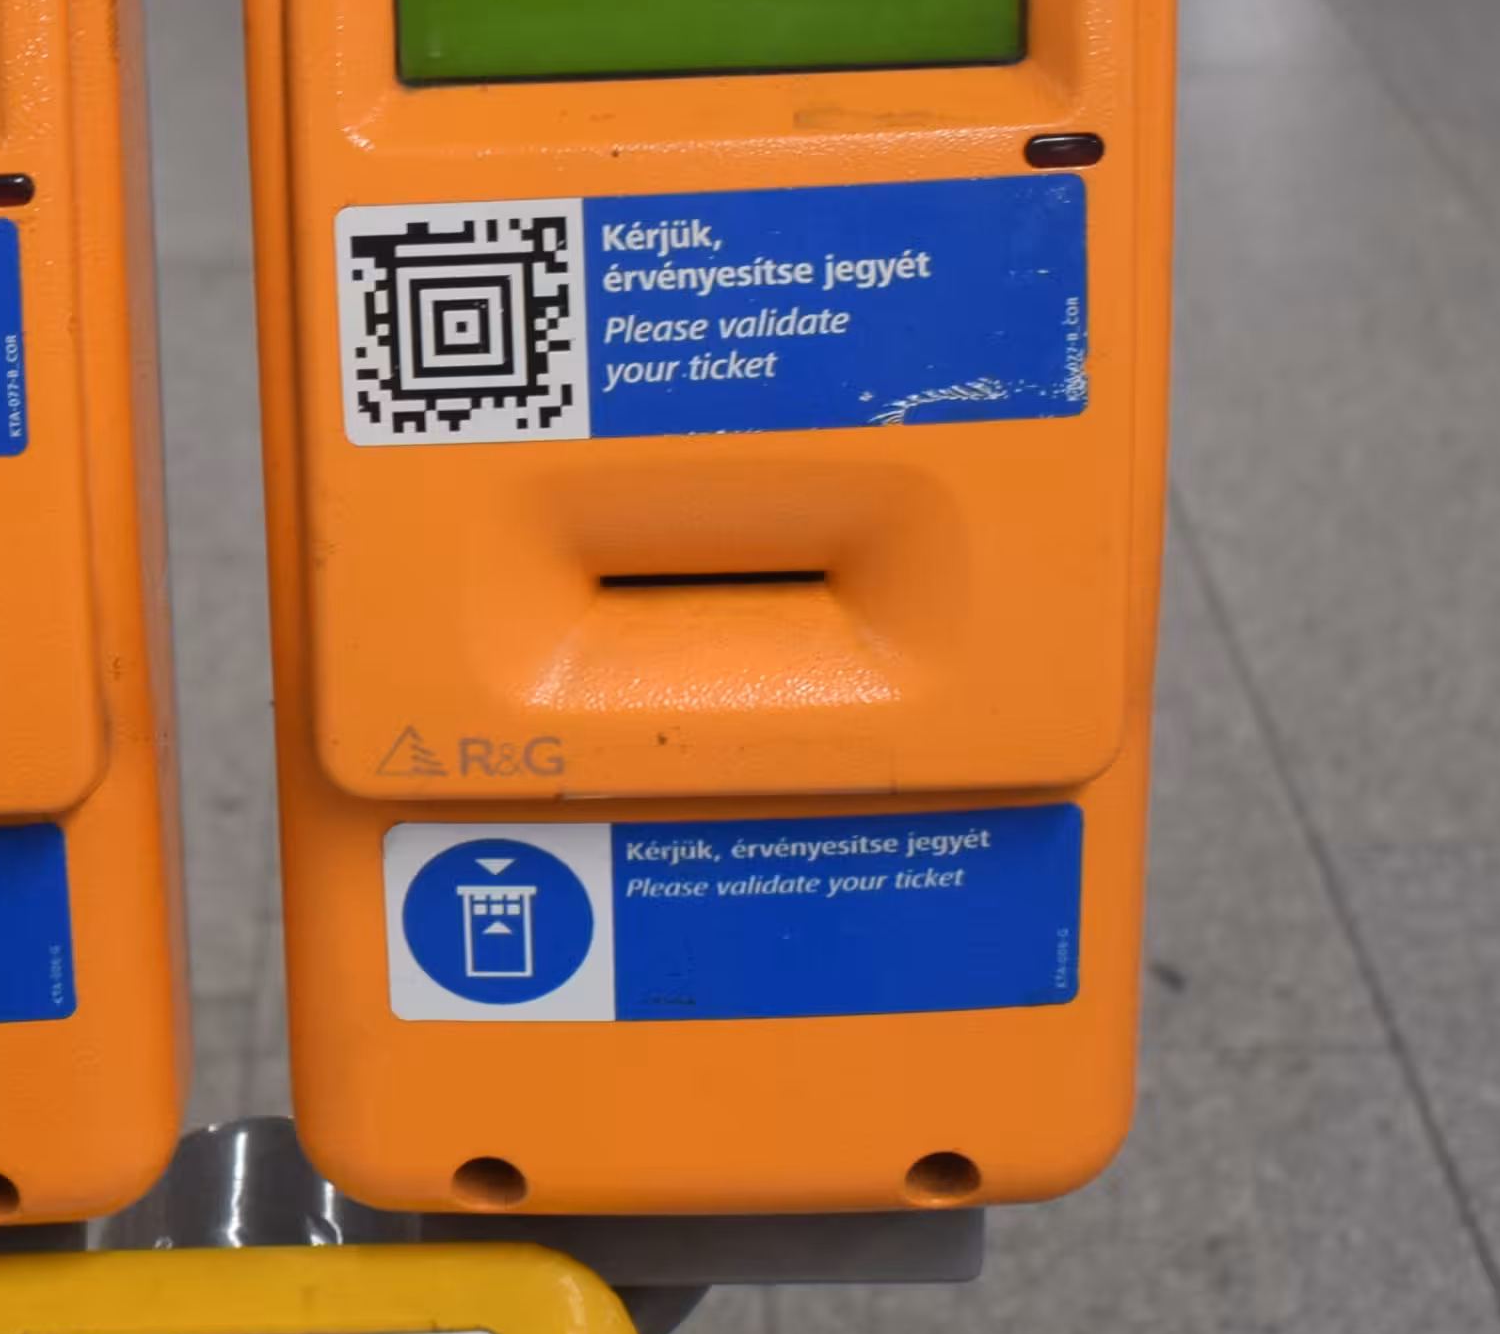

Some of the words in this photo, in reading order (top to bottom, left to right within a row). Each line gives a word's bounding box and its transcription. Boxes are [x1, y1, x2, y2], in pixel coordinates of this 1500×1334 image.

[602, 219, 722, 257] Kérjük,
[603, 255, 814, 296] érvényesítse
[822, 249, 932, 290] jegyét
[603, 314, 709, 344] Please
[718, 305, 850, 339] validate
[603, 360, 681, 392] your
[688, 349, 778, 381] ticket
[458, 736, 565, 777] R&G
[626, 838, 721, 864] Kérjük,
[730, 834, 899, 862] érvényesítse
[905, 829, 992, 857] jegyét
[626, 878, 707, 898] Please
[716, 873, 820, 896] validate
[827, 875, 887, 897] your
[895, 868, 965, 888] ticket
